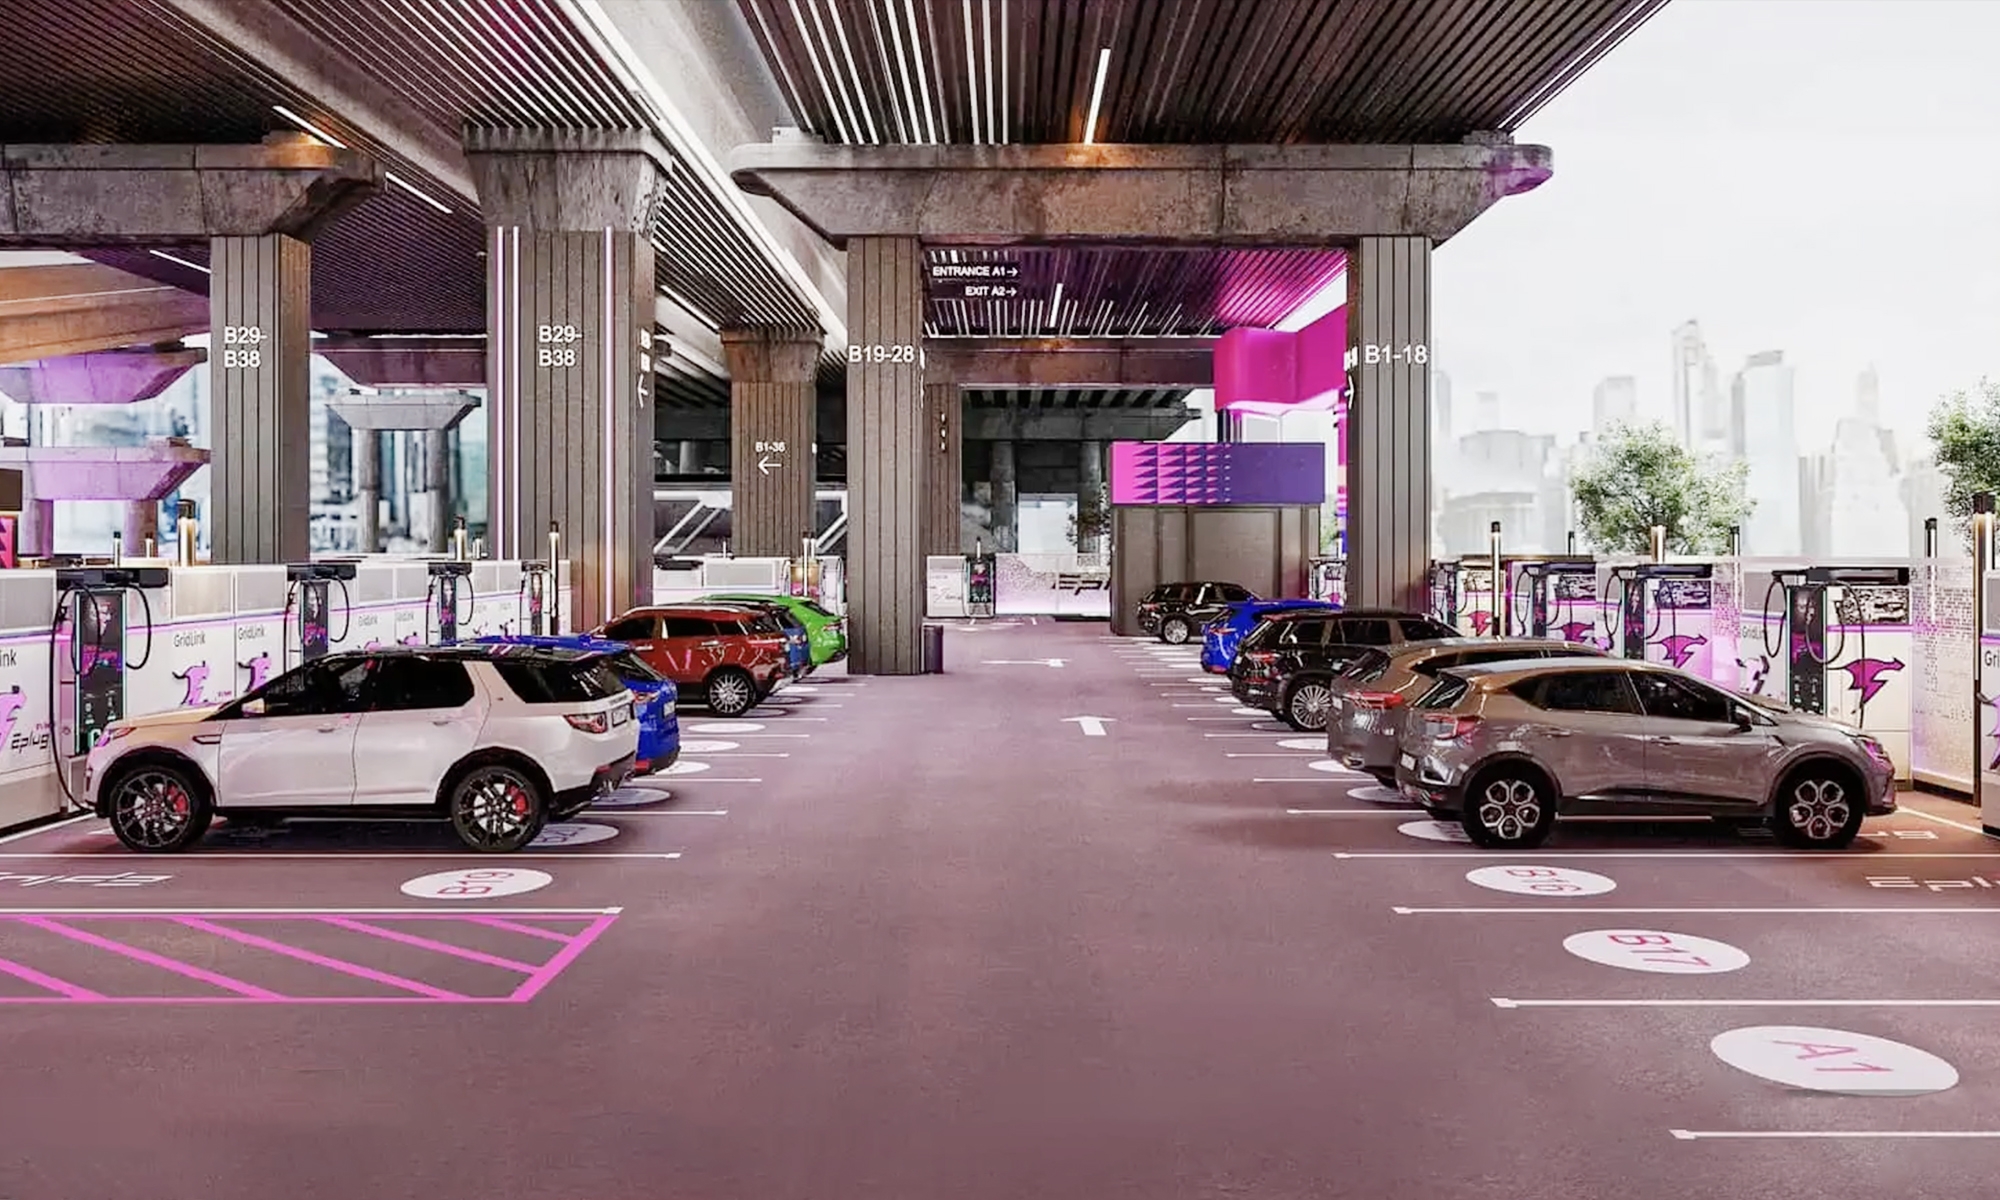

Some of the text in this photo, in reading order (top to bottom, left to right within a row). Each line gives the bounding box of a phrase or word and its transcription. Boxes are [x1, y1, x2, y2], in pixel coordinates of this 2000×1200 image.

[932, 265, 1006, 277] ENTRANCE A1
[965, 285, 1006, 297] EXIT A2
[224, 326, 268, 344] B29-
[539, 325, 582, 342] B29-
[224, 350, 261, 368] B38
[539, 349, 575, 367] B38
[848, 345, 914, 363] B19-28
[1365, 344, 1428, 364] B1-18
[173, 631, 206, 648] GridLink
[238, 625, 264, 641] GridLink
[11, 730, 50, 754] Eplug
[437, 871, 515, 894] B19
[1506, 868, 1582, 893] B16
[1608, 934, 1712, 967] B17
[1772, 1040, 1893, 1072] A1
